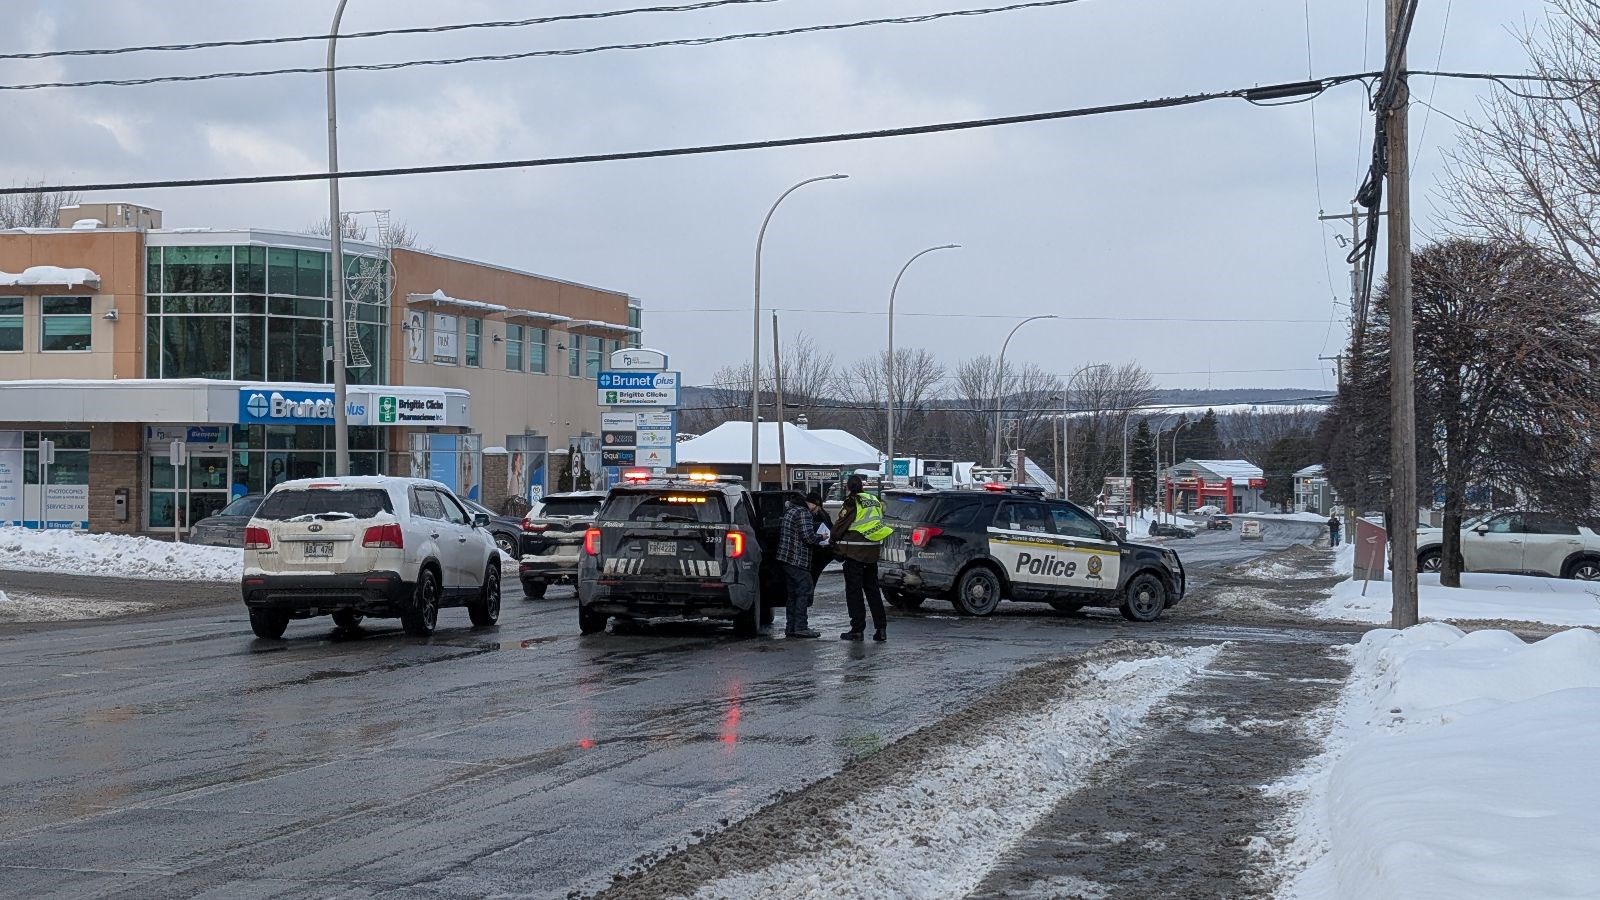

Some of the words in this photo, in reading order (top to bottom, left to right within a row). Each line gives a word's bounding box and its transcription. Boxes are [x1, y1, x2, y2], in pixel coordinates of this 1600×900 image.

[612, 375, 651, 386] Brunet
[656, 377, 674, 385] plus
[270, 394, 334, 418] Brunet
[347, 402, 365, 415] lus
[398, 399, 424, 411] Brigitte
[1016, 552, 1077, 577] Police
